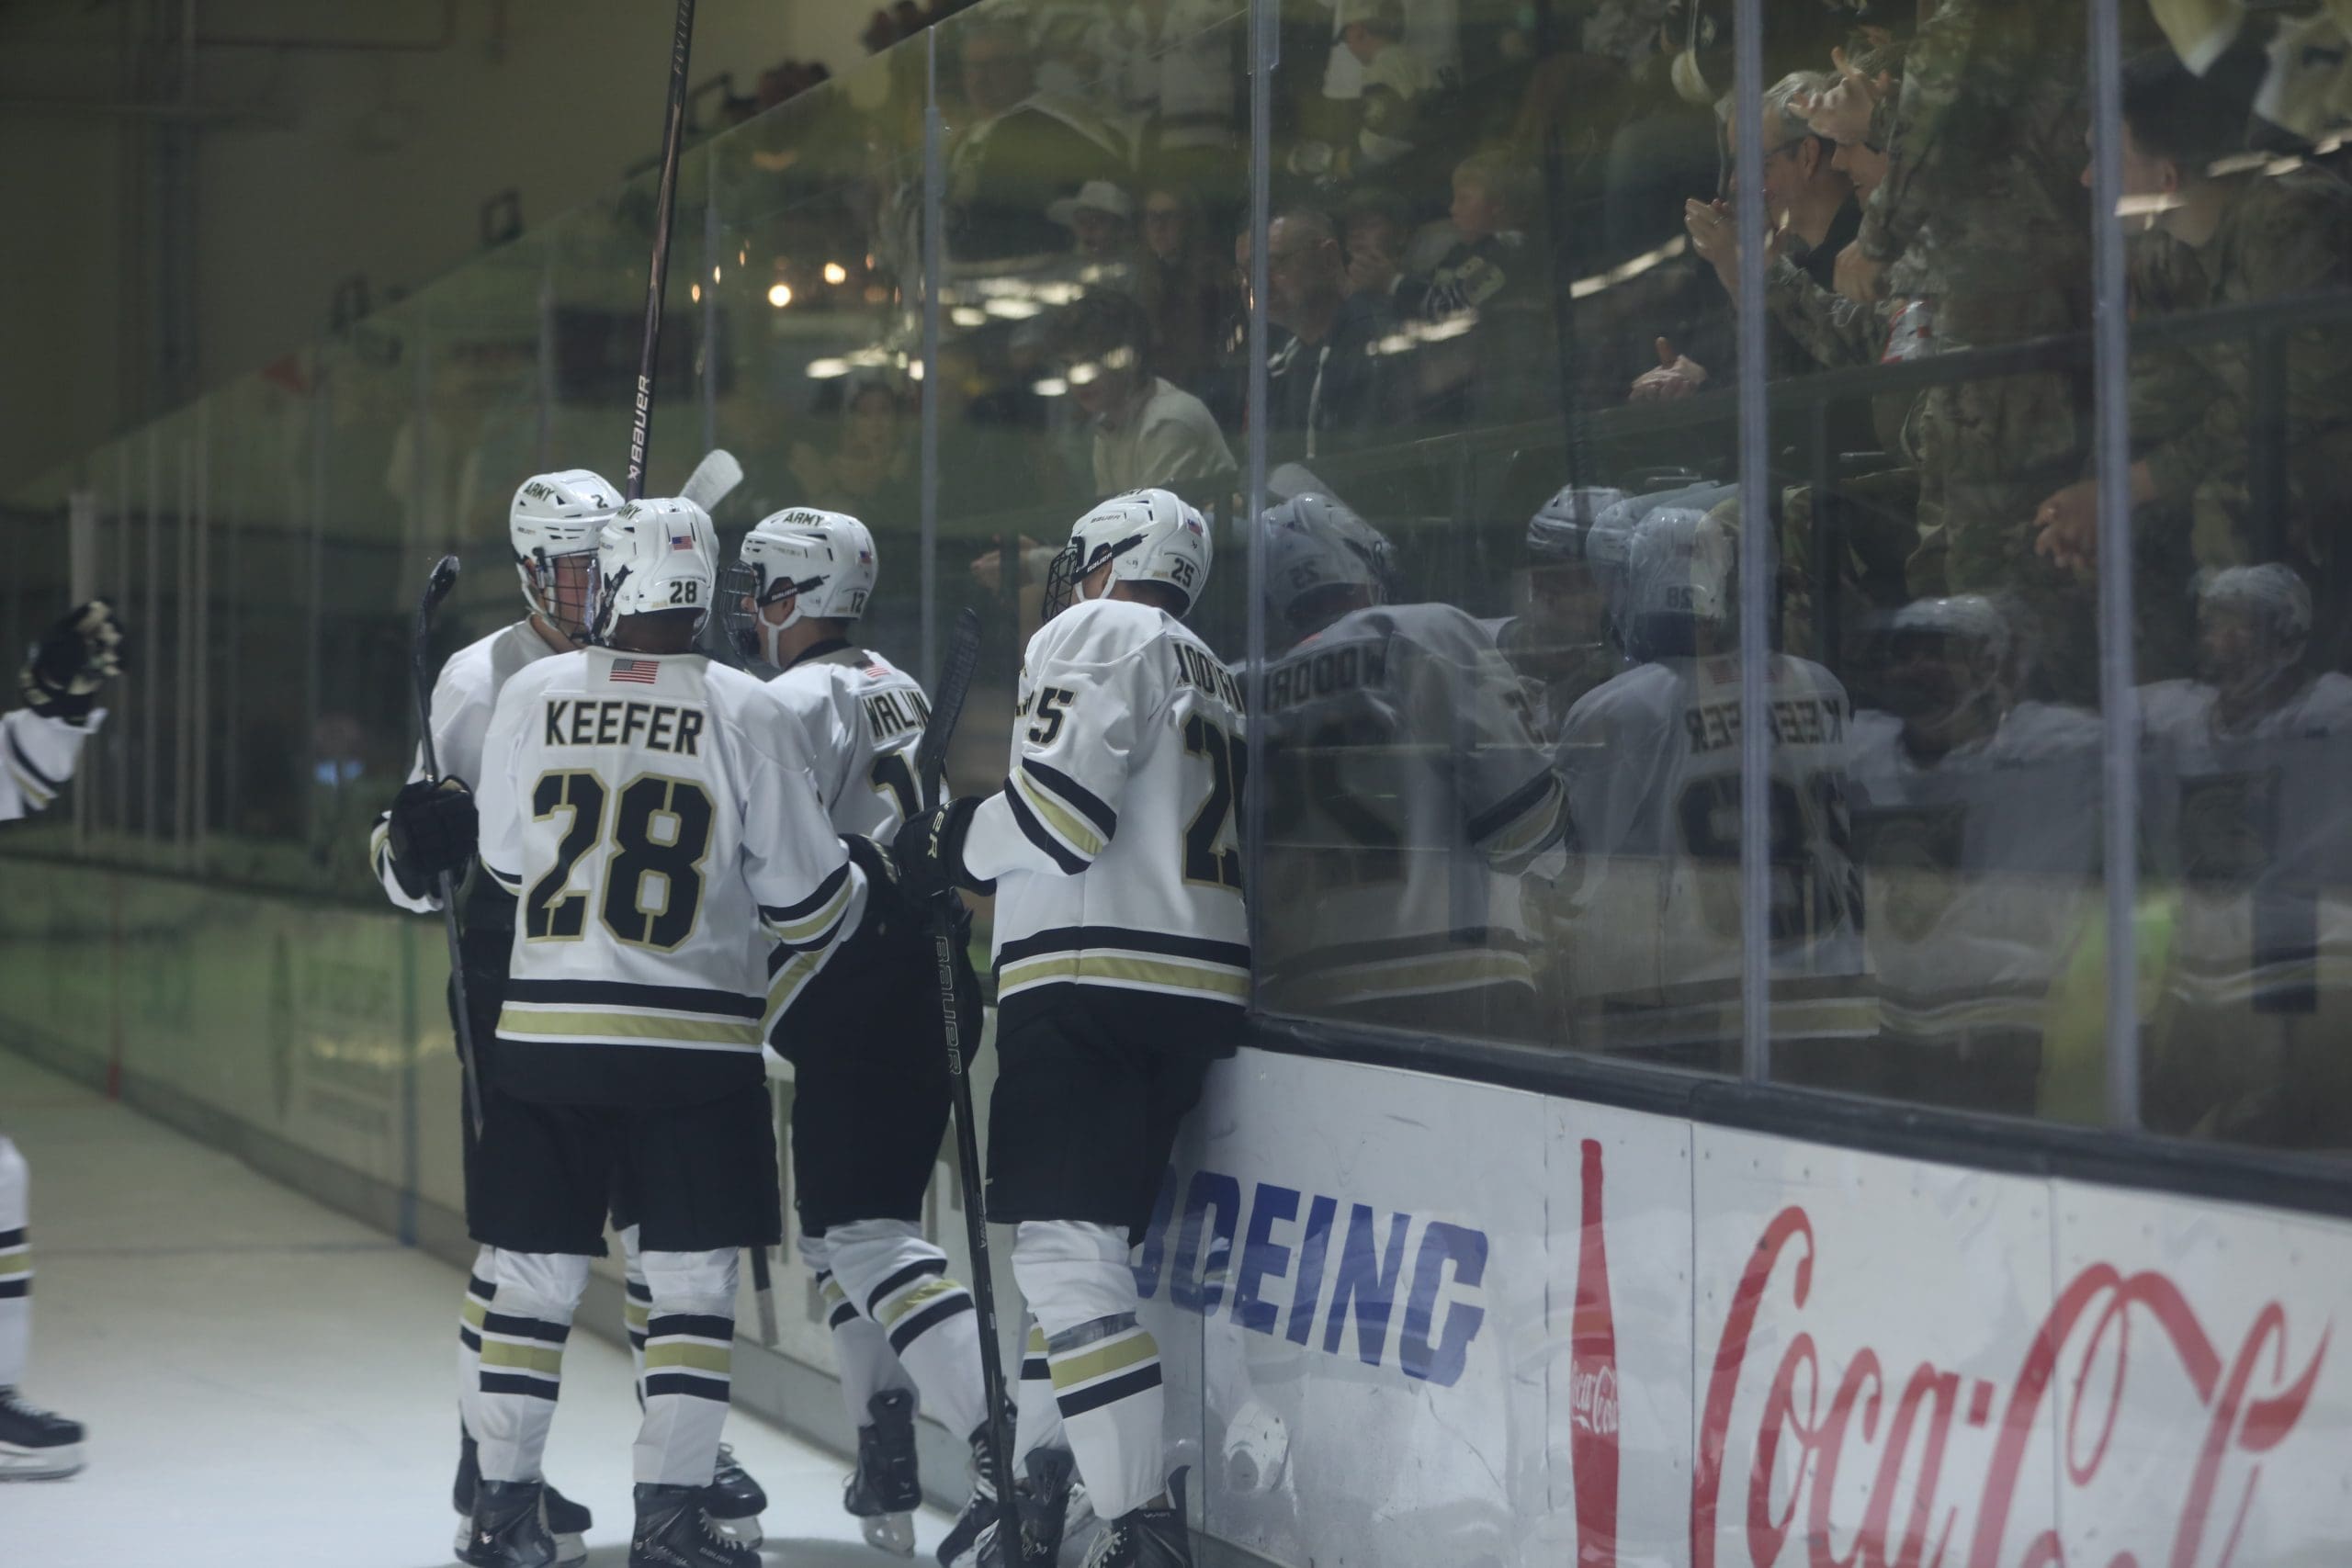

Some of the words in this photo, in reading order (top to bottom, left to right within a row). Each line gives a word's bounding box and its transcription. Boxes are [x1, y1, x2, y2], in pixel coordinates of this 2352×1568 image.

[630, 375, 650, 463] BAUER
[524, 481, 555, 502] ARMY
[784, 512, 824, 526] ARMY
[1086, 551, 1113, 572] BAUER
[1171, 558, 1194, 588] 25
[670, 581, 697, 604] 28
[546, 701, 705, 756] KEEFER
[526, 769, 718, 953] 28
